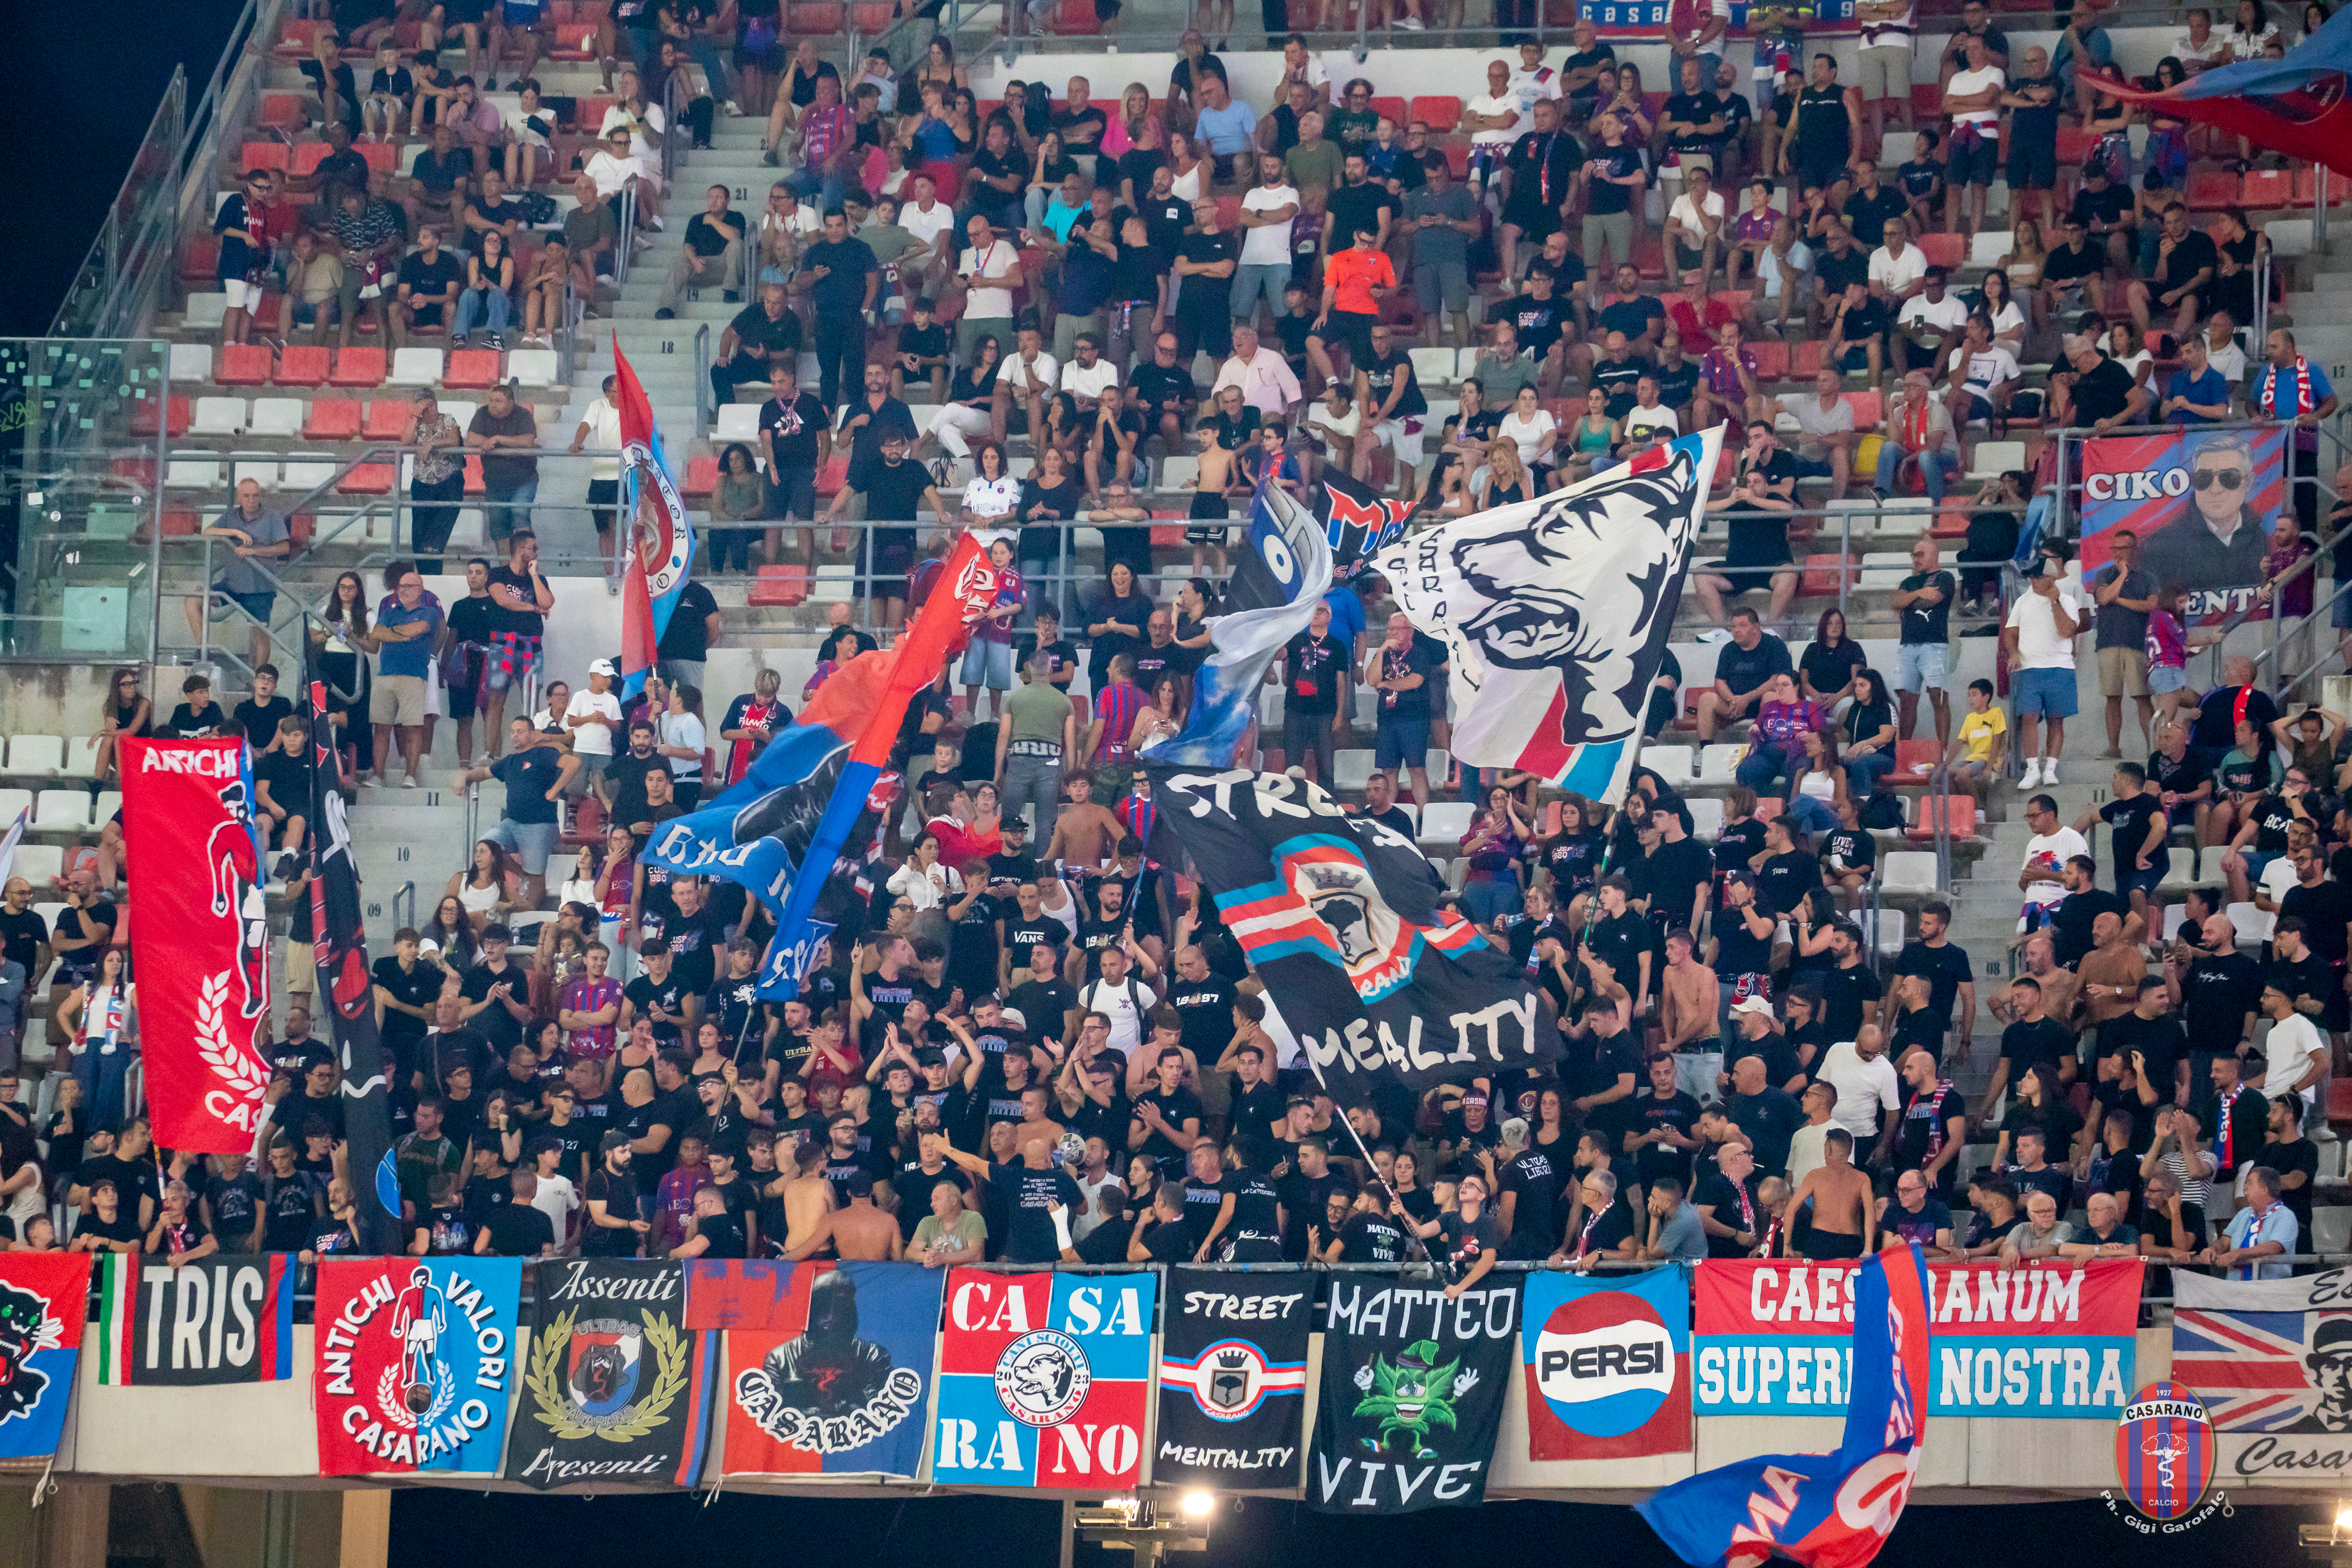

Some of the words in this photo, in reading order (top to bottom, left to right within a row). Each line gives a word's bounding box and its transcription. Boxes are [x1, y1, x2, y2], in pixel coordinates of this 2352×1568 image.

[735, 188, 747, 200] 21
[662, 340, 674, 354] 18
[2334, 365, 2346, 378] 17
[2086, 467, 2190, 500] CIKO
[142, 747, 239, 778] ANTICHI
[427, 792, 440, 806] 11
[2093, 790, 2105, 803] 11
[397, 847, 410, 861] 10
[368, 903, 381, 918] 09
[1014, 931, 1045, 943] VANS
[1201, 994, 1219, 1003] 97
[566, 1140, 579, 1150] 27
[316, 1233, 339, 1244] CUSP
[1367, 1223, 1401, 1238] MATTEO
[1372, 1247, 1395, 1262] VIVE
[549, 1261, 682, 1301] Assenti
[143, 1265, 264, 1370] TRIS
[1184, 1291, 1304, 1320] STREET
[1327, 1281, 1516, 1340] MATTEO
[324, 1274, 397, 1395] ANTICHI
[446, 1271, 506, 1390] VALORI
[573, 1318, 642, 1339] ULTRAS
[1001, 1334, 1033, 1368] CANI
[1035, 1332, 1085, 1369] SCIOLTI
[1541, 1340, 1663, 1382] PERSI
[996, 1370, 1012, 1382] 20
[1074, 1373, 1089, 1385] 23
[1940, 1348, 2126, 1406] NOSTRA
[560, 1399, 639, 1429] CASARANO
[737, 1370, 920, 1451] CASARANO
[1000, 1387, 1083, 1425] CASARANO
[1204, 1405, 1250, 1420] CASARANO
[343, 1399, 490, 1465] CASARANO
[521, 1445, 667, 1483] Presenti
[1160, 1440, 1294, 1470] MENTALITY
[1319, 1452, 1482, 1506] VIVE
